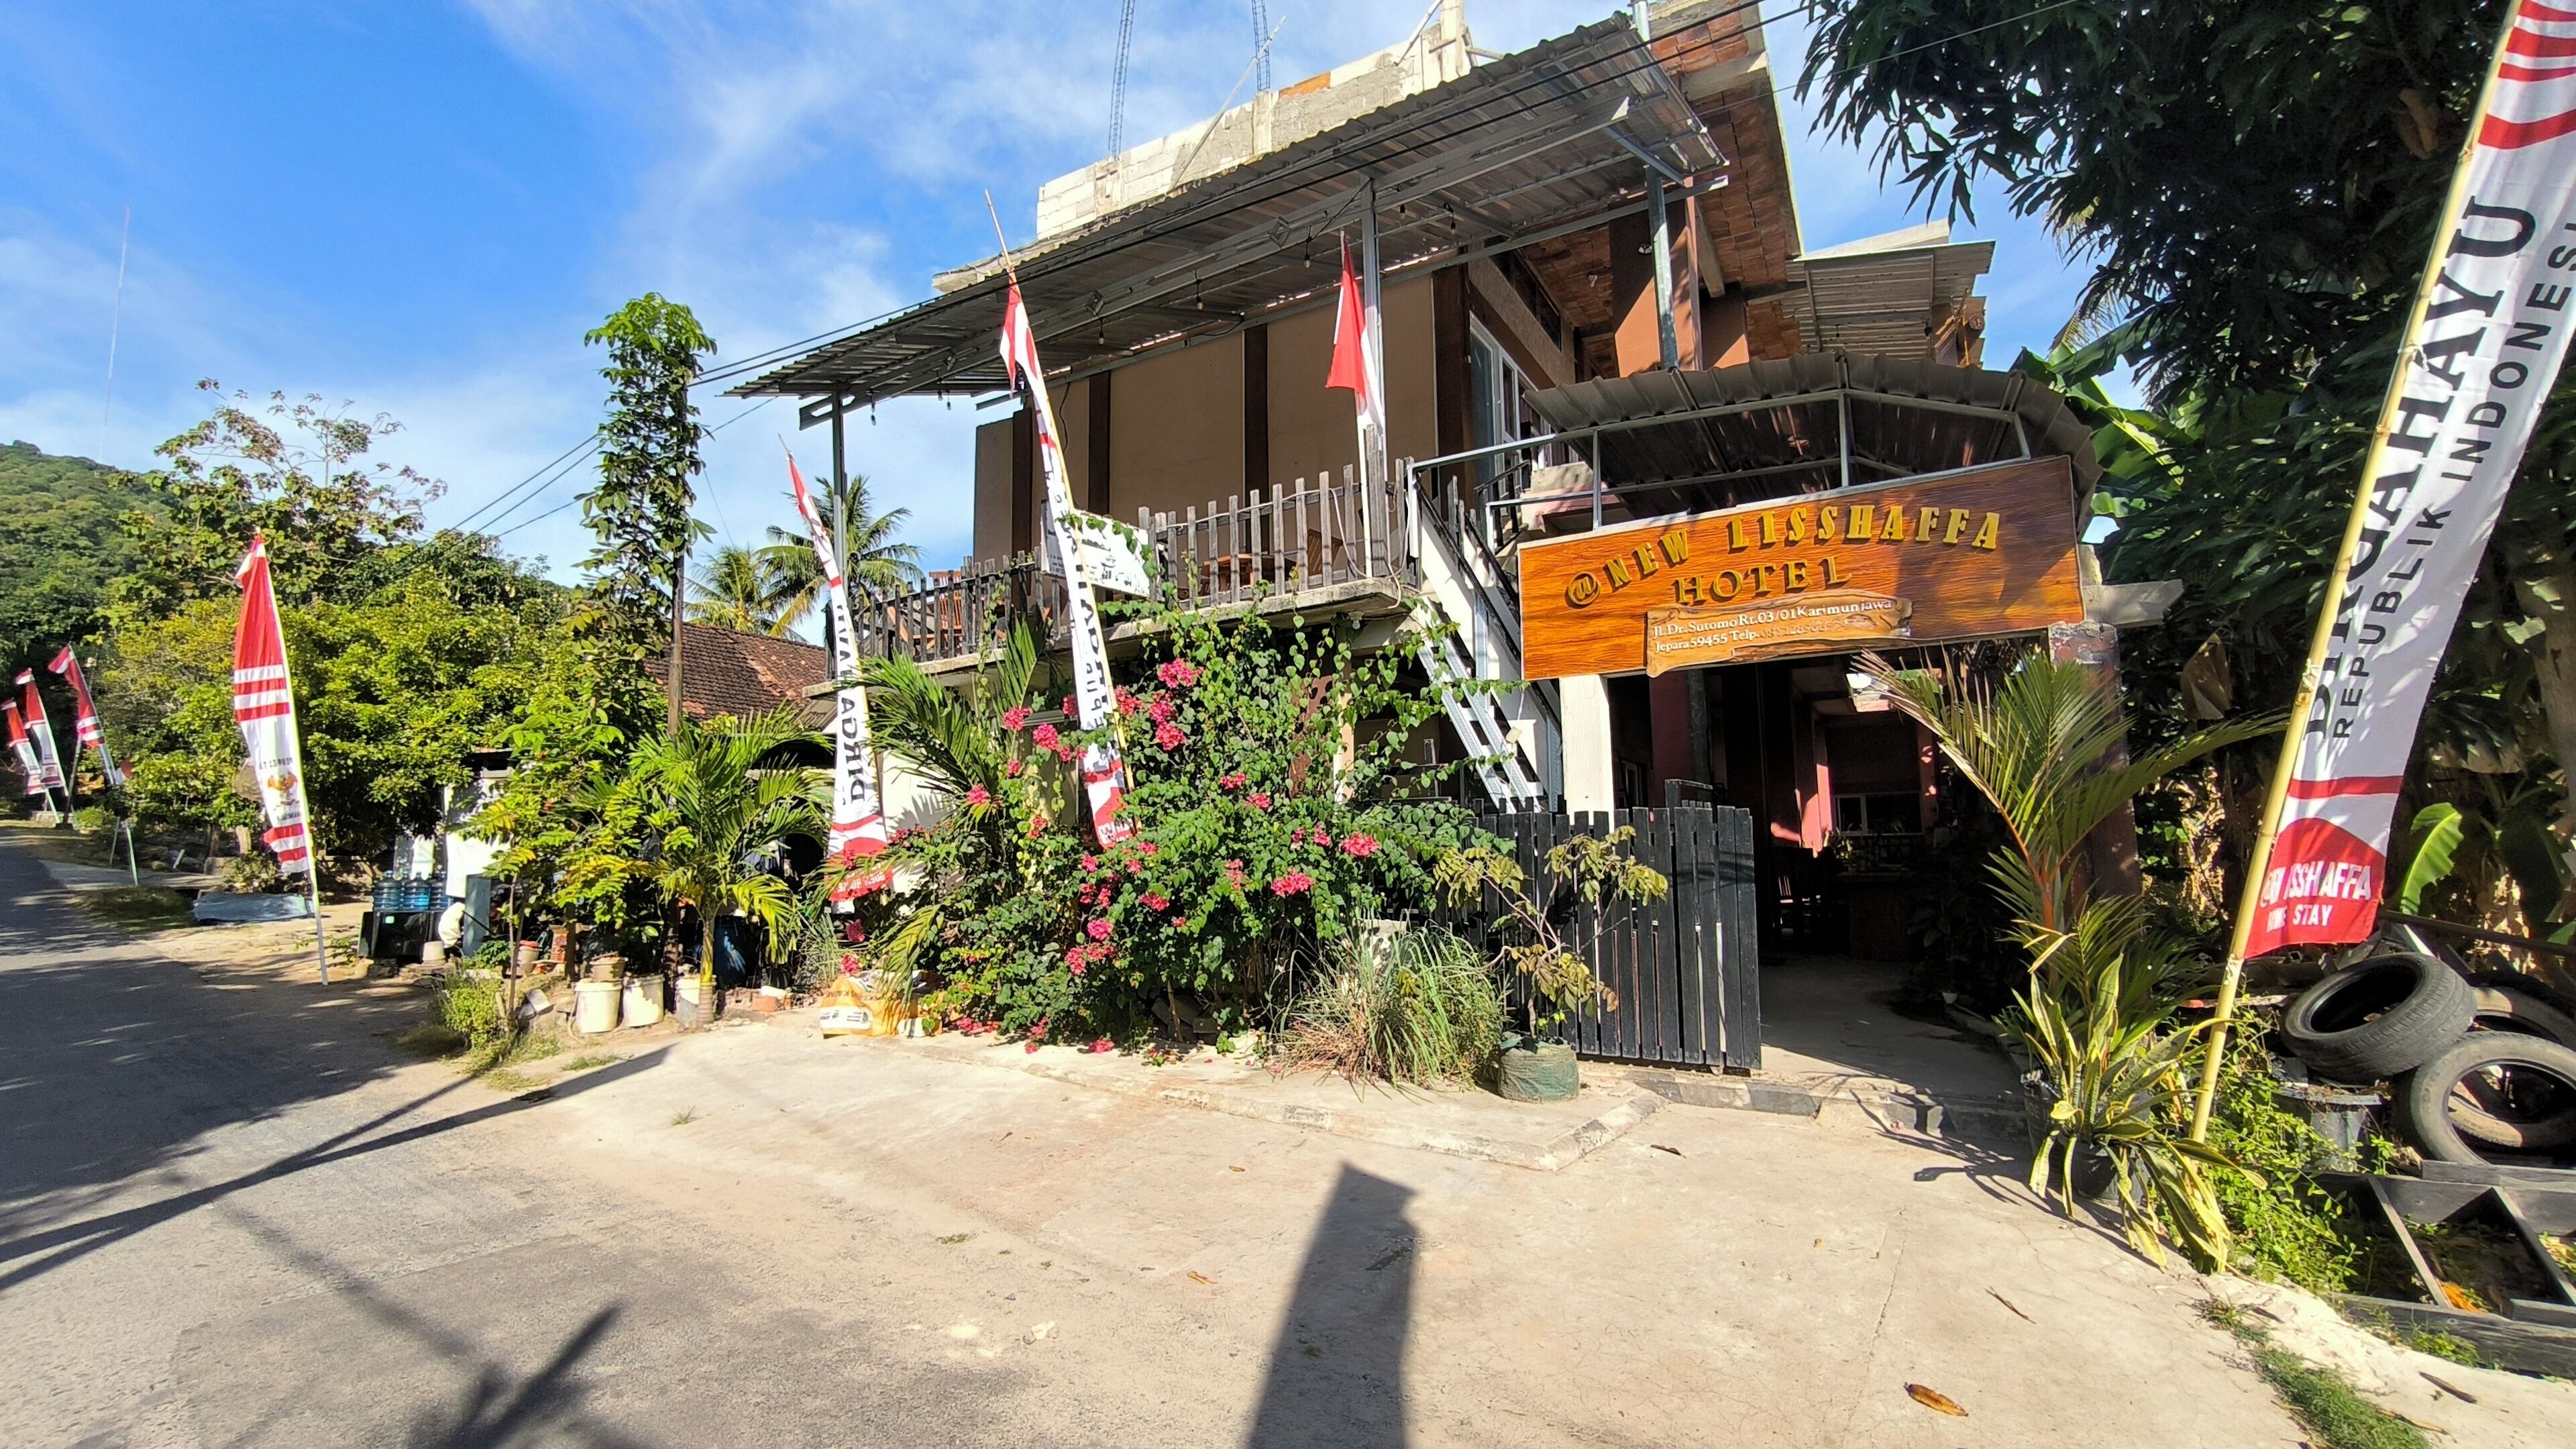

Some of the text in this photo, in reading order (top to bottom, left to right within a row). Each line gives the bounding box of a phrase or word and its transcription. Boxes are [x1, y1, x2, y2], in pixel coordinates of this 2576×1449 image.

[1729, 504, 2000, 550] LISSHAFFA
[1677, 555, 1853, 604] HOTEL
[1654, 641, 1689, 653] Jepara
[1689, 633, 1728, 649] 59455
[2333, 508, 2453, 738] REPUBLIK
[2292, 904, 2333, 926] STAY
